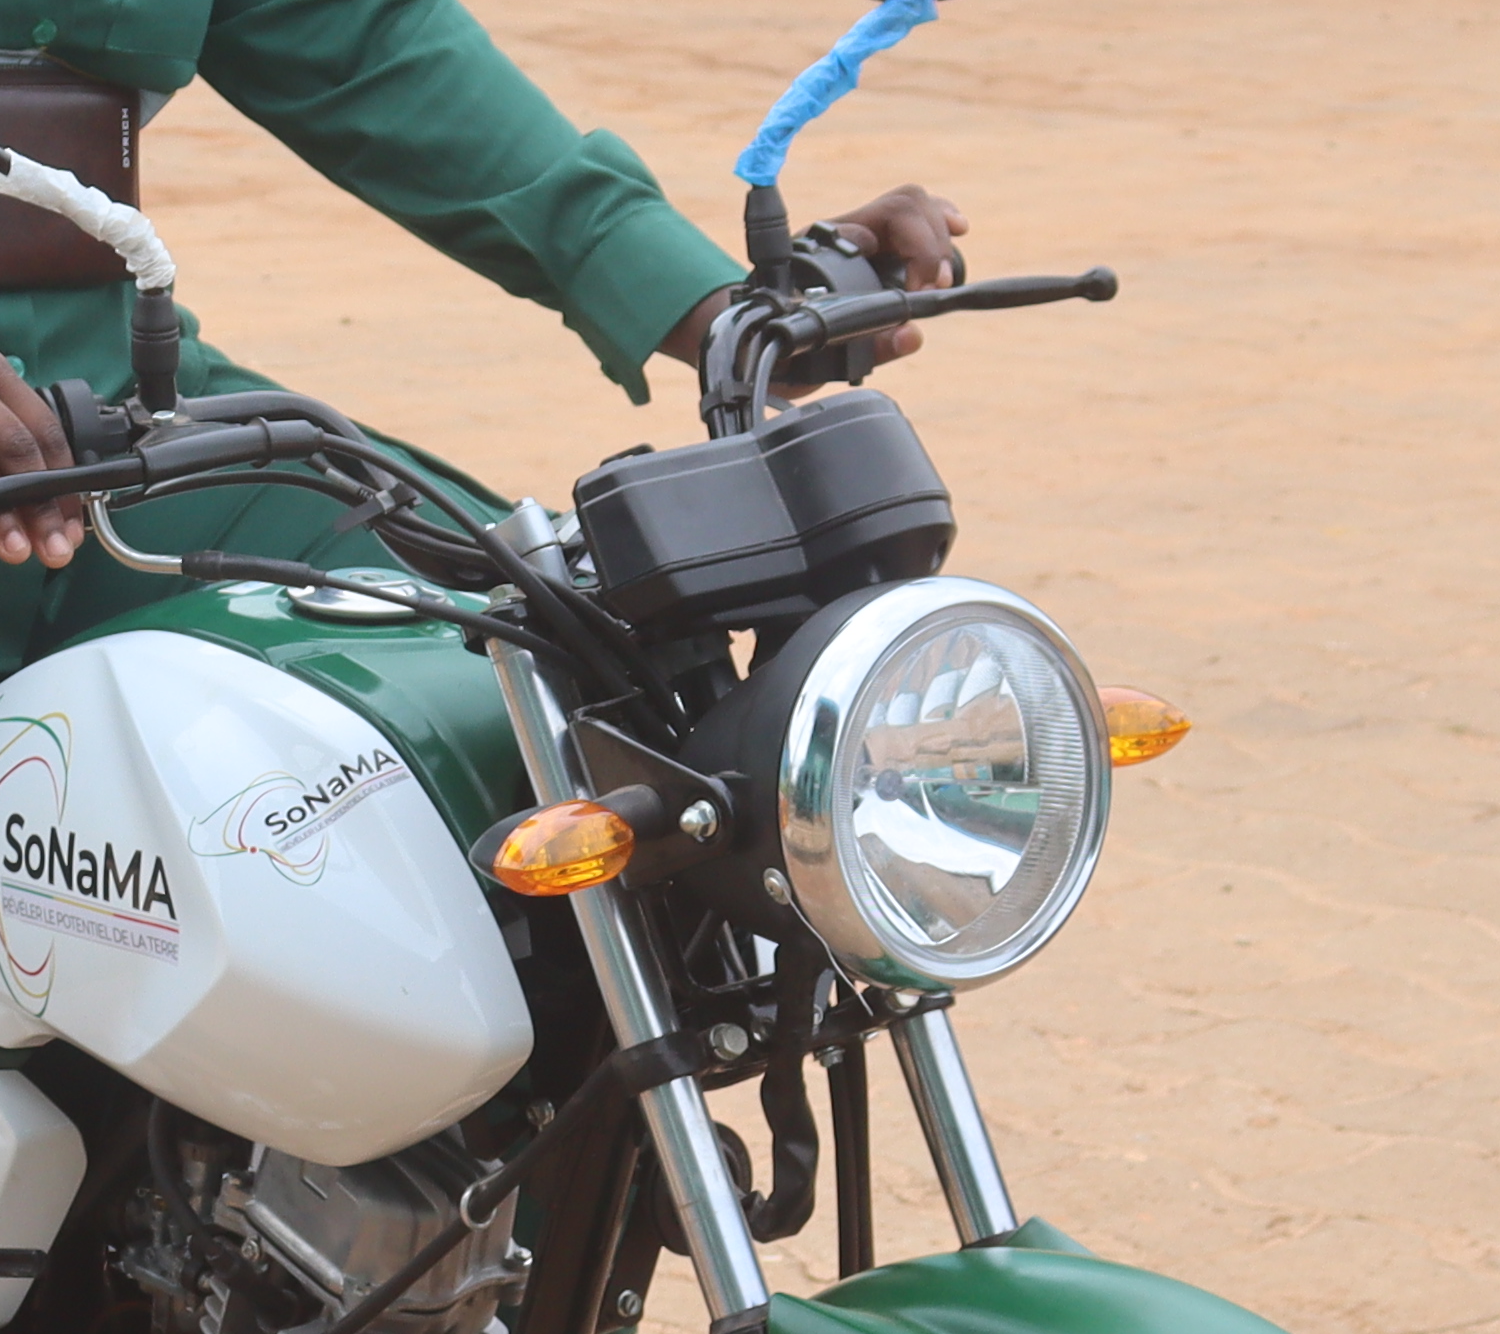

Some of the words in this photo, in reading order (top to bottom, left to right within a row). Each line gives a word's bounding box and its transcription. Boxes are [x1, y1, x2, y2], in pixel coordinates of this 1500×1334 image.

[264, 748, 399, 836] SoNaMA
[3, 812, 177, 920] SoNaMA
[44, 908, 55, 926] LE
[56, 911, 112, 941] POTENTIEL
[112, 927, 130, 946] DE
[130, 932, 147, 951] LA
[147, 935, 179, 960] TERRE
